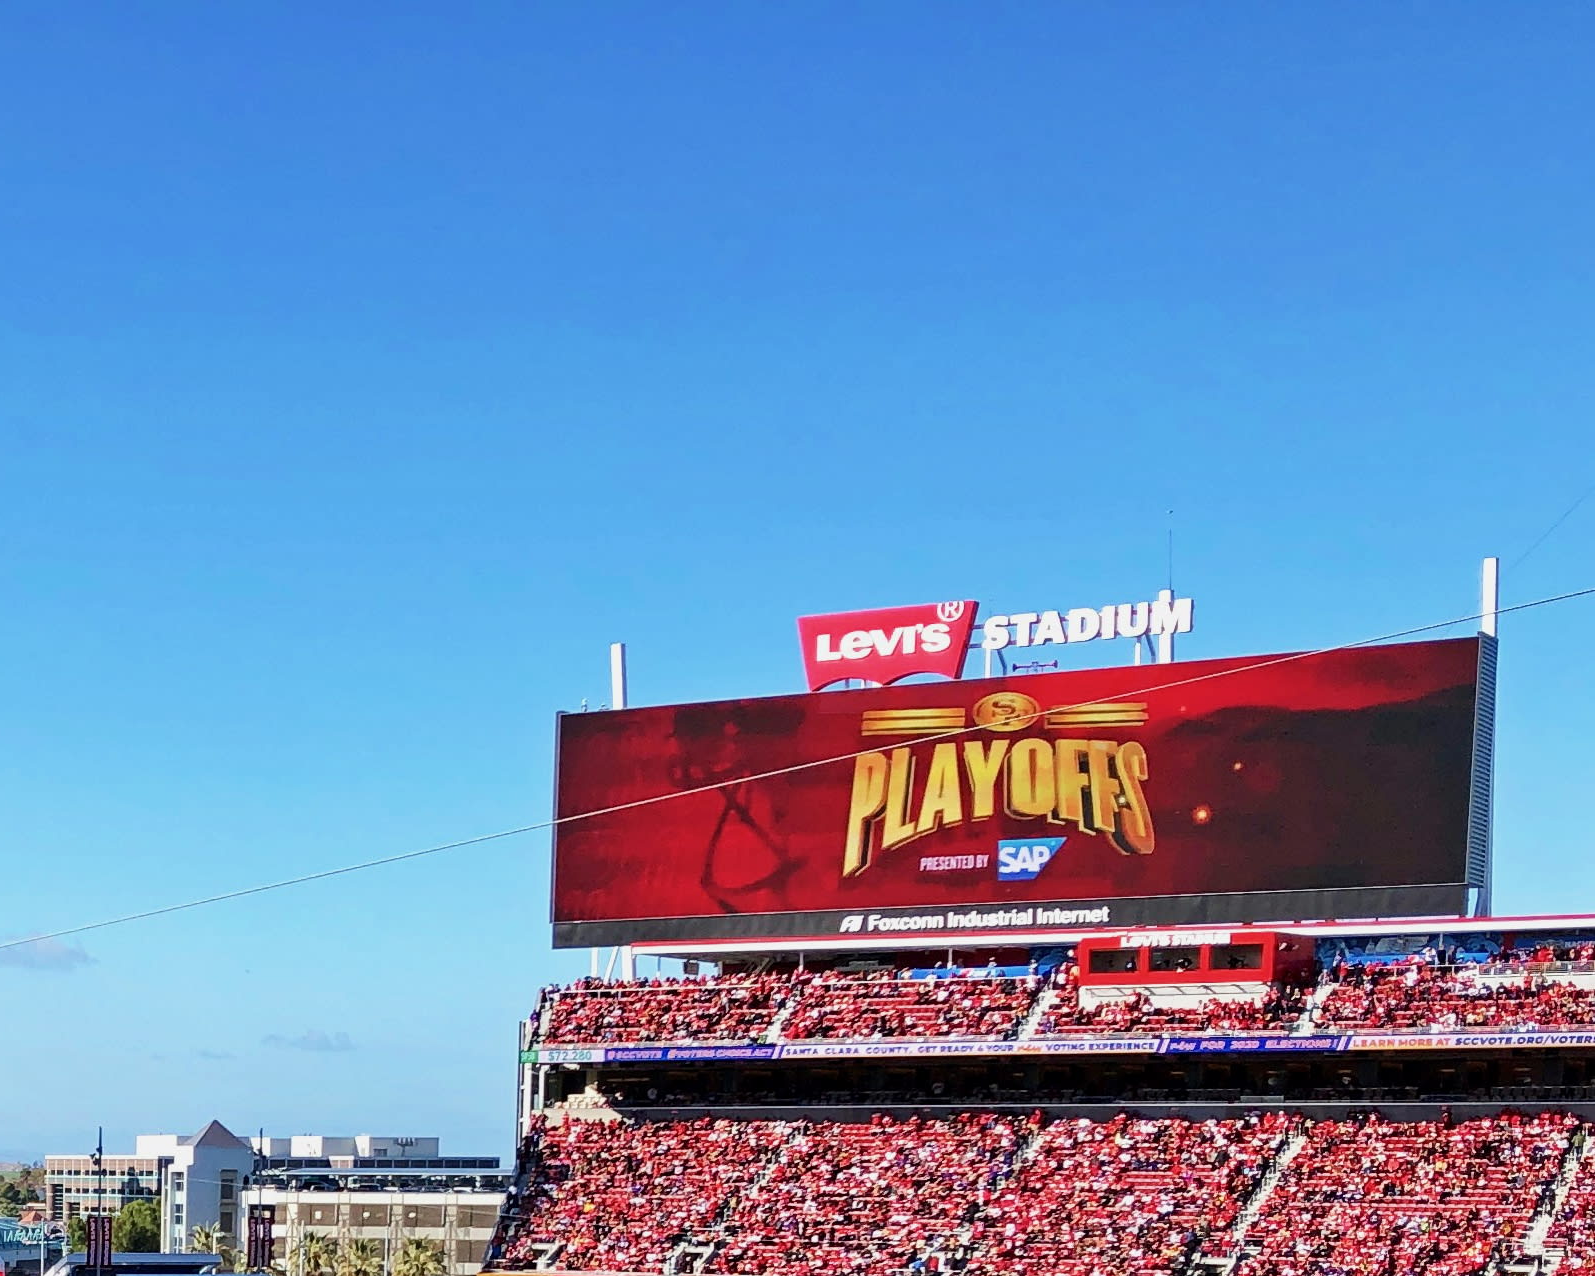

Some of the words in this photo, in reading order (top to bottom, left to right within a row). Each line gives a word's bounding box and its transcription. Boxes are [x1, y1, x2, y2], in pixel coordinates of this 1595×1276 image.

[982, 599, 1194, 650] STADIUM
[842, 738, 1154, 877] PLAYOFFS
[919, 856, 975, 872] PRESENTED
[977, 854, 990, 868] BY
[998, 846, 1050, 873] SAP
[867, 912, 944, 932] Foxconn
[947, 908, 1032, 928] Industrial
[1035, 905, 1110, 925] Internet
[785, 1047, 818, 1056] SANTA
[825, 1047, 859, 1055] CLARA
[940, 1045, 974, 1053] READY
[1045, 1043, 1086, 1051] VOTING
[1088, 1042, 1154, 1051] EXPERIENCE
[1353, 1038, 1395, 1048] LEARN
[1398, 1038, 1432, 1047] MORE
[1436, 1038, 1450, 1046] AT
